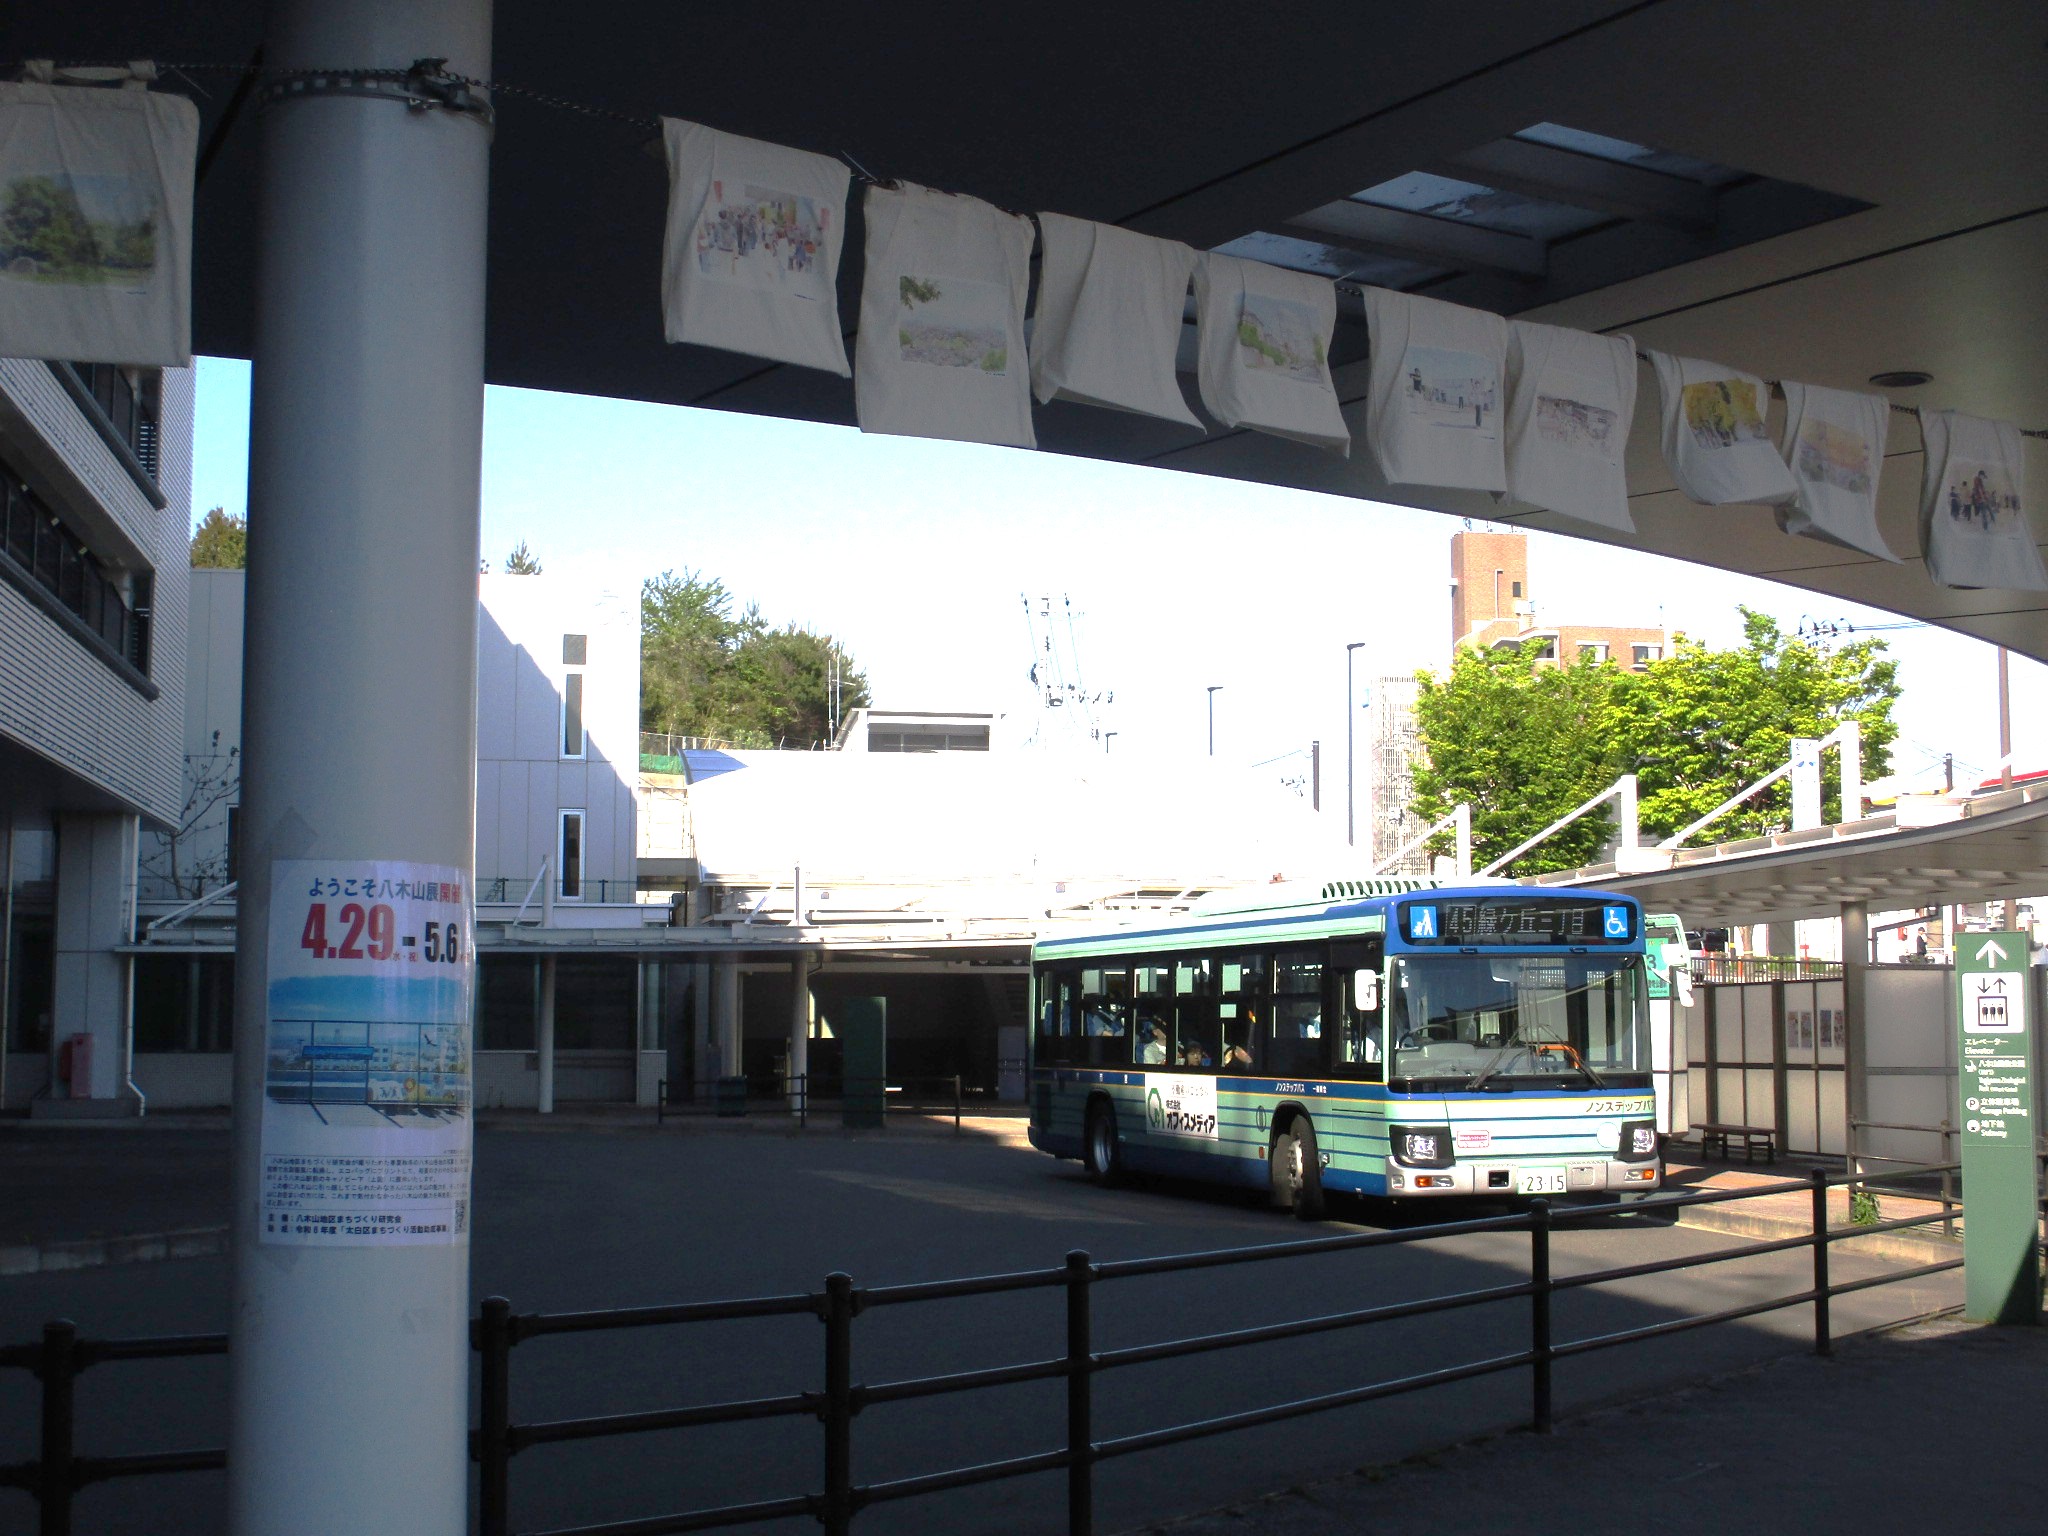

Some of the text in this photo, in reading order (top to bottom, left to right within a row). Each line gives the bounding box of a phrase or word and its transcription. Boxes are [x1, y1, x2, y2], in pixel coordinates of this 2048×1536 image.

[301, 903, 394, 961] 4.29
[425, 921, 458, 964] 5.6
[1964, 1037, 2008, 1046] エレベーター
[1964, 1047, 1995, 1055] Elevator
[1166, 1111, 1216, 1134] オフィスメディア
[1981, 1129, 2008, 1139] Subway
